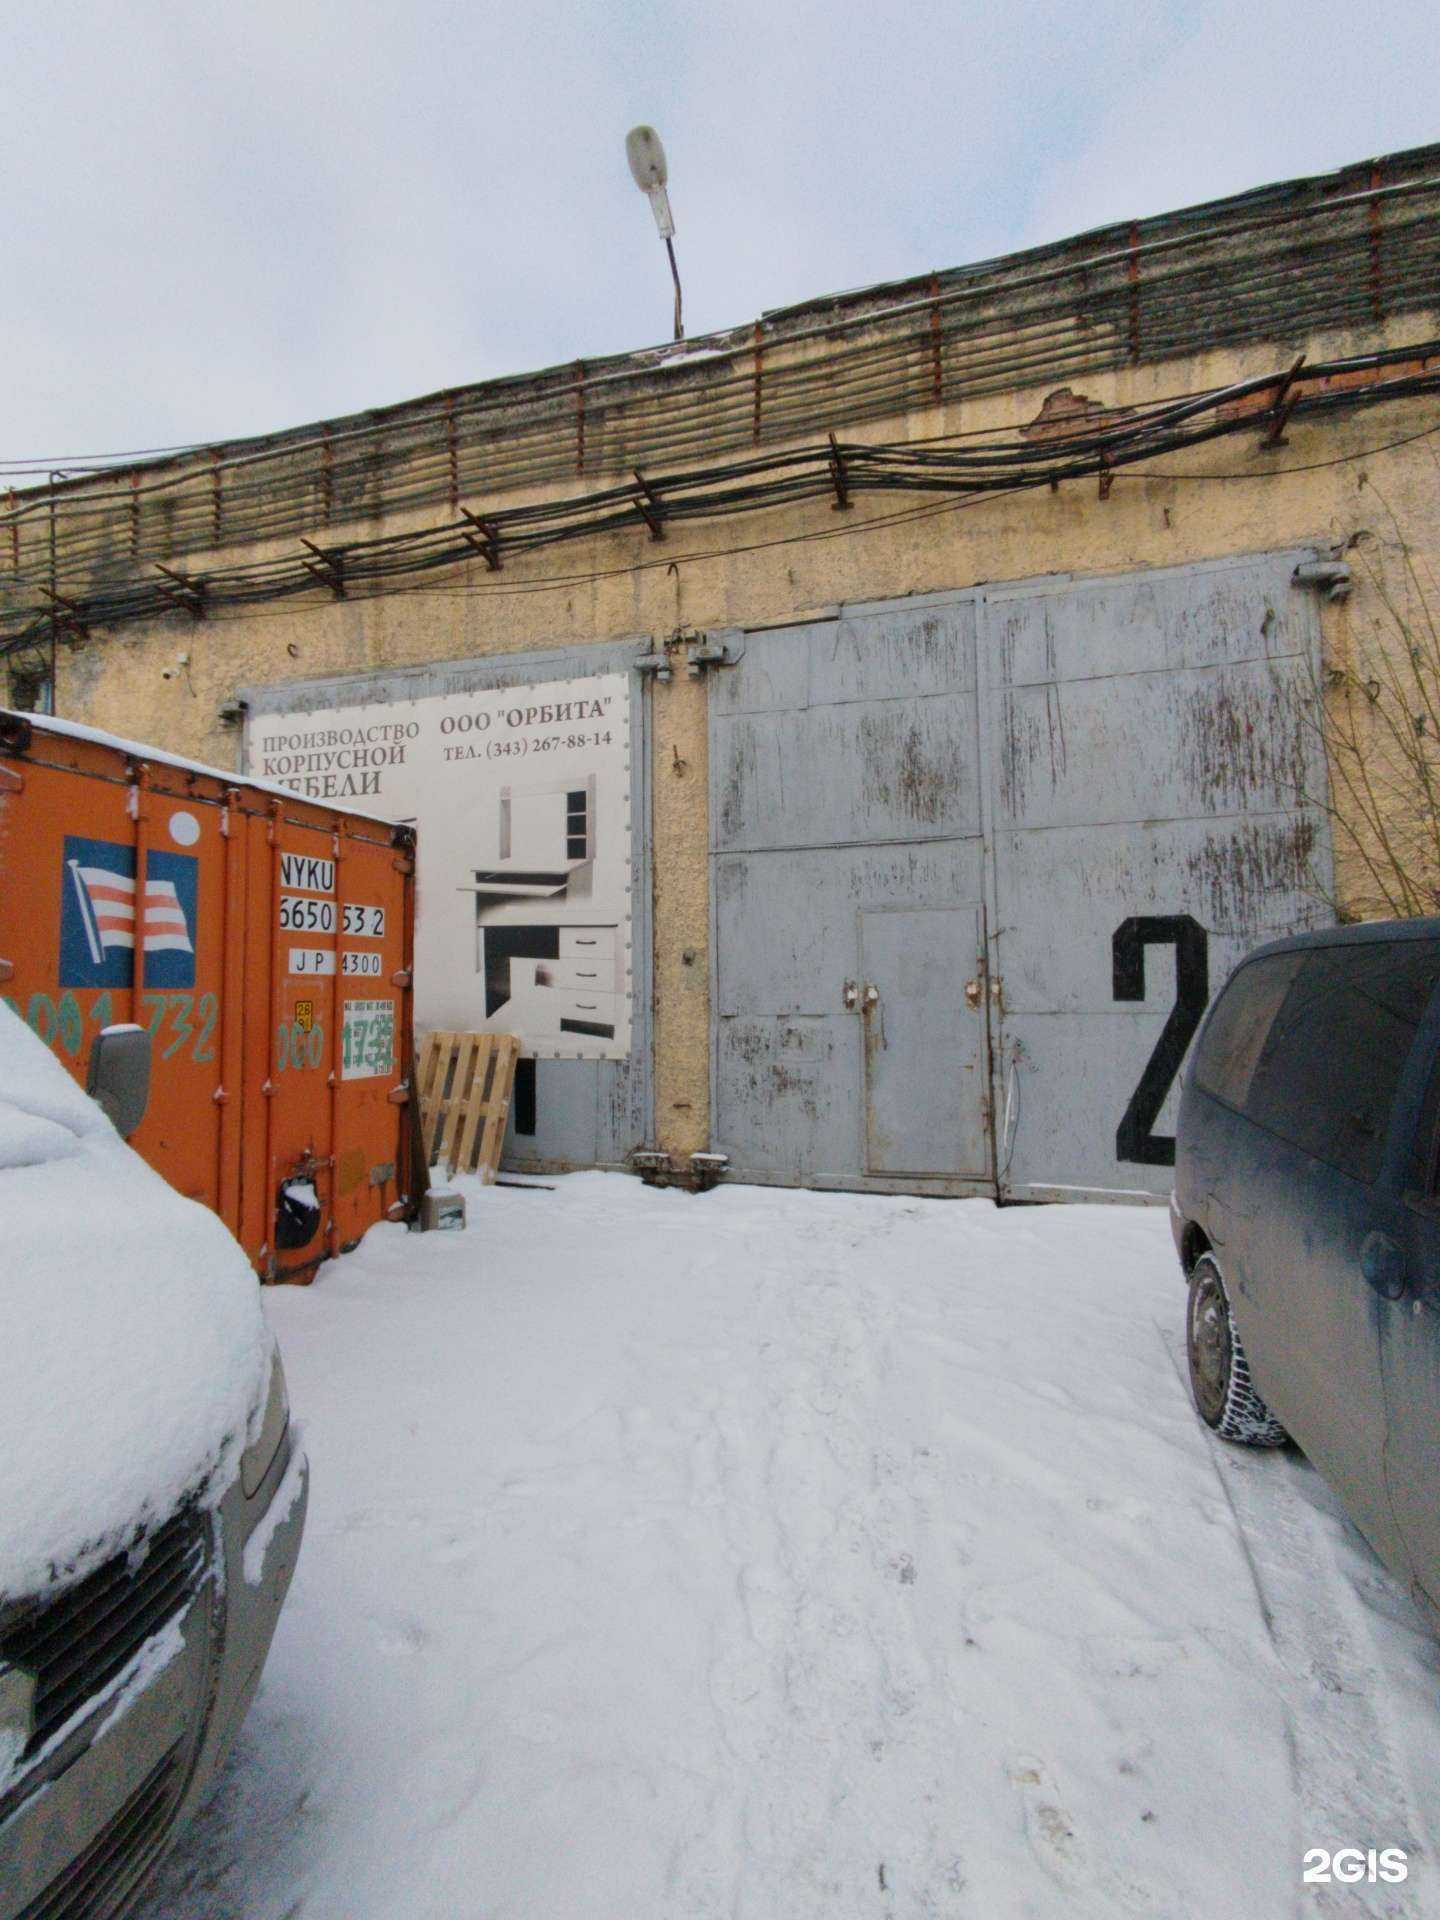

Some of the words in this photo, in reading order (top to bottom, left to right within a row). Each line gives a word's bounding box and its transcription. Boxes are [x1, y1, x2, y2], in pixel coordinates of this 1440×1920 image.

[440, 712, 491, 734] ООО
[497, 697, 612, 727] "ОРБИТА"
[263, 722, 420, 752] ПРОИЗВОДСТВО
[443, 746, 481, 761] ТЕЛ.
[486, 738, 528, 760] (343)
[532, 731, 612, 752] 267-88-14
[263, 740, 407, 776] КОРПУСНОЙ
[277, 771, 382, 799] ЕБЕЛИ
[281, 856, 333, 890] NYKU
[1112, 914, 1209, 1166] 2
